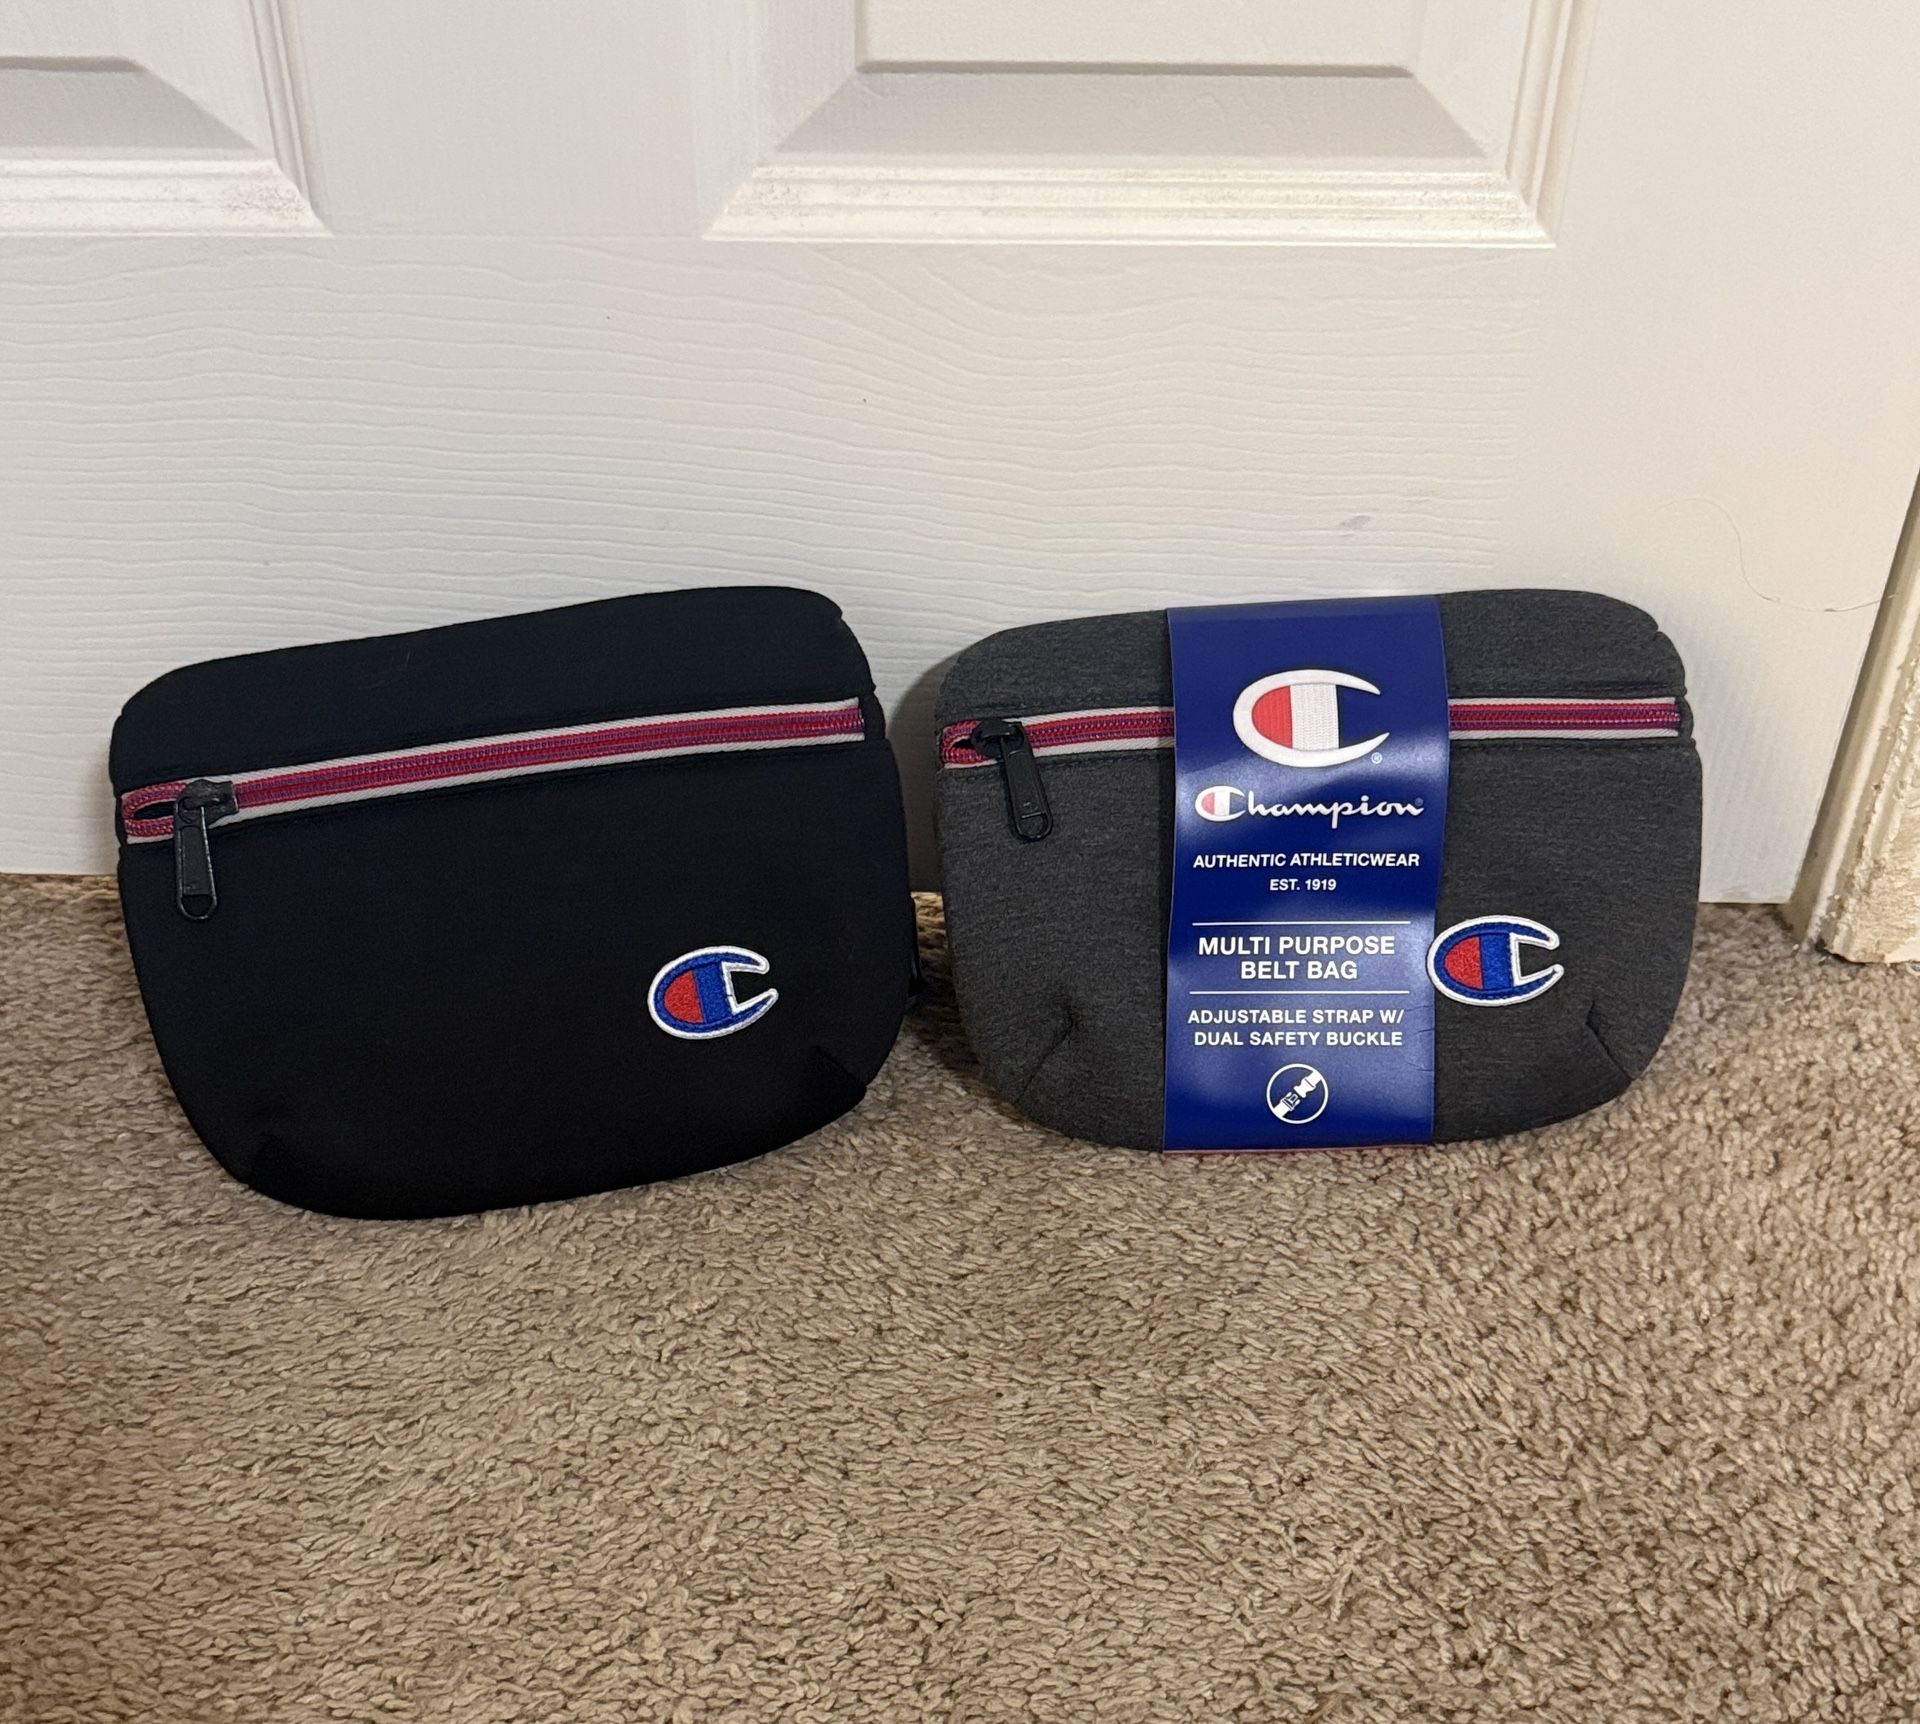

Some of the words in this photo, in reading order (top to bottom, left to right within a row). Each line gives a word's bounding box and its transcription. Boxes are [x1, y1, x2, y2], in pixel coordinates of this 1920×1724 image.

[1194, 785, 1424, 829] Champion
[1192, 853, 1287, 869] AUTHENTIC
[1289, 852, 1420, 868] ATHLETICWEAR
[1269, 878, 1301, 891] EST.
[1305, 878, 1337, 891] 1919
[1197, 936, 1271, 956] MULTI
[1278, 935, 1396, 955] PURPOSE
[1240, 961, 1300, 980] BELT
[1307, 960, 1358, 980] BAG
[1187, 1009, 1307, 1025] ADJUSTABLE
[1312, 1009, 1374, 1024] STRAP
[1379, 1009, 1405, 1024] W/
[1193, 1031, 1244, 1046] DUAL
[1249, 1031, 1321, 1046] SAFETY
[1326, 1031, 1403, 1046] BUCKLE
